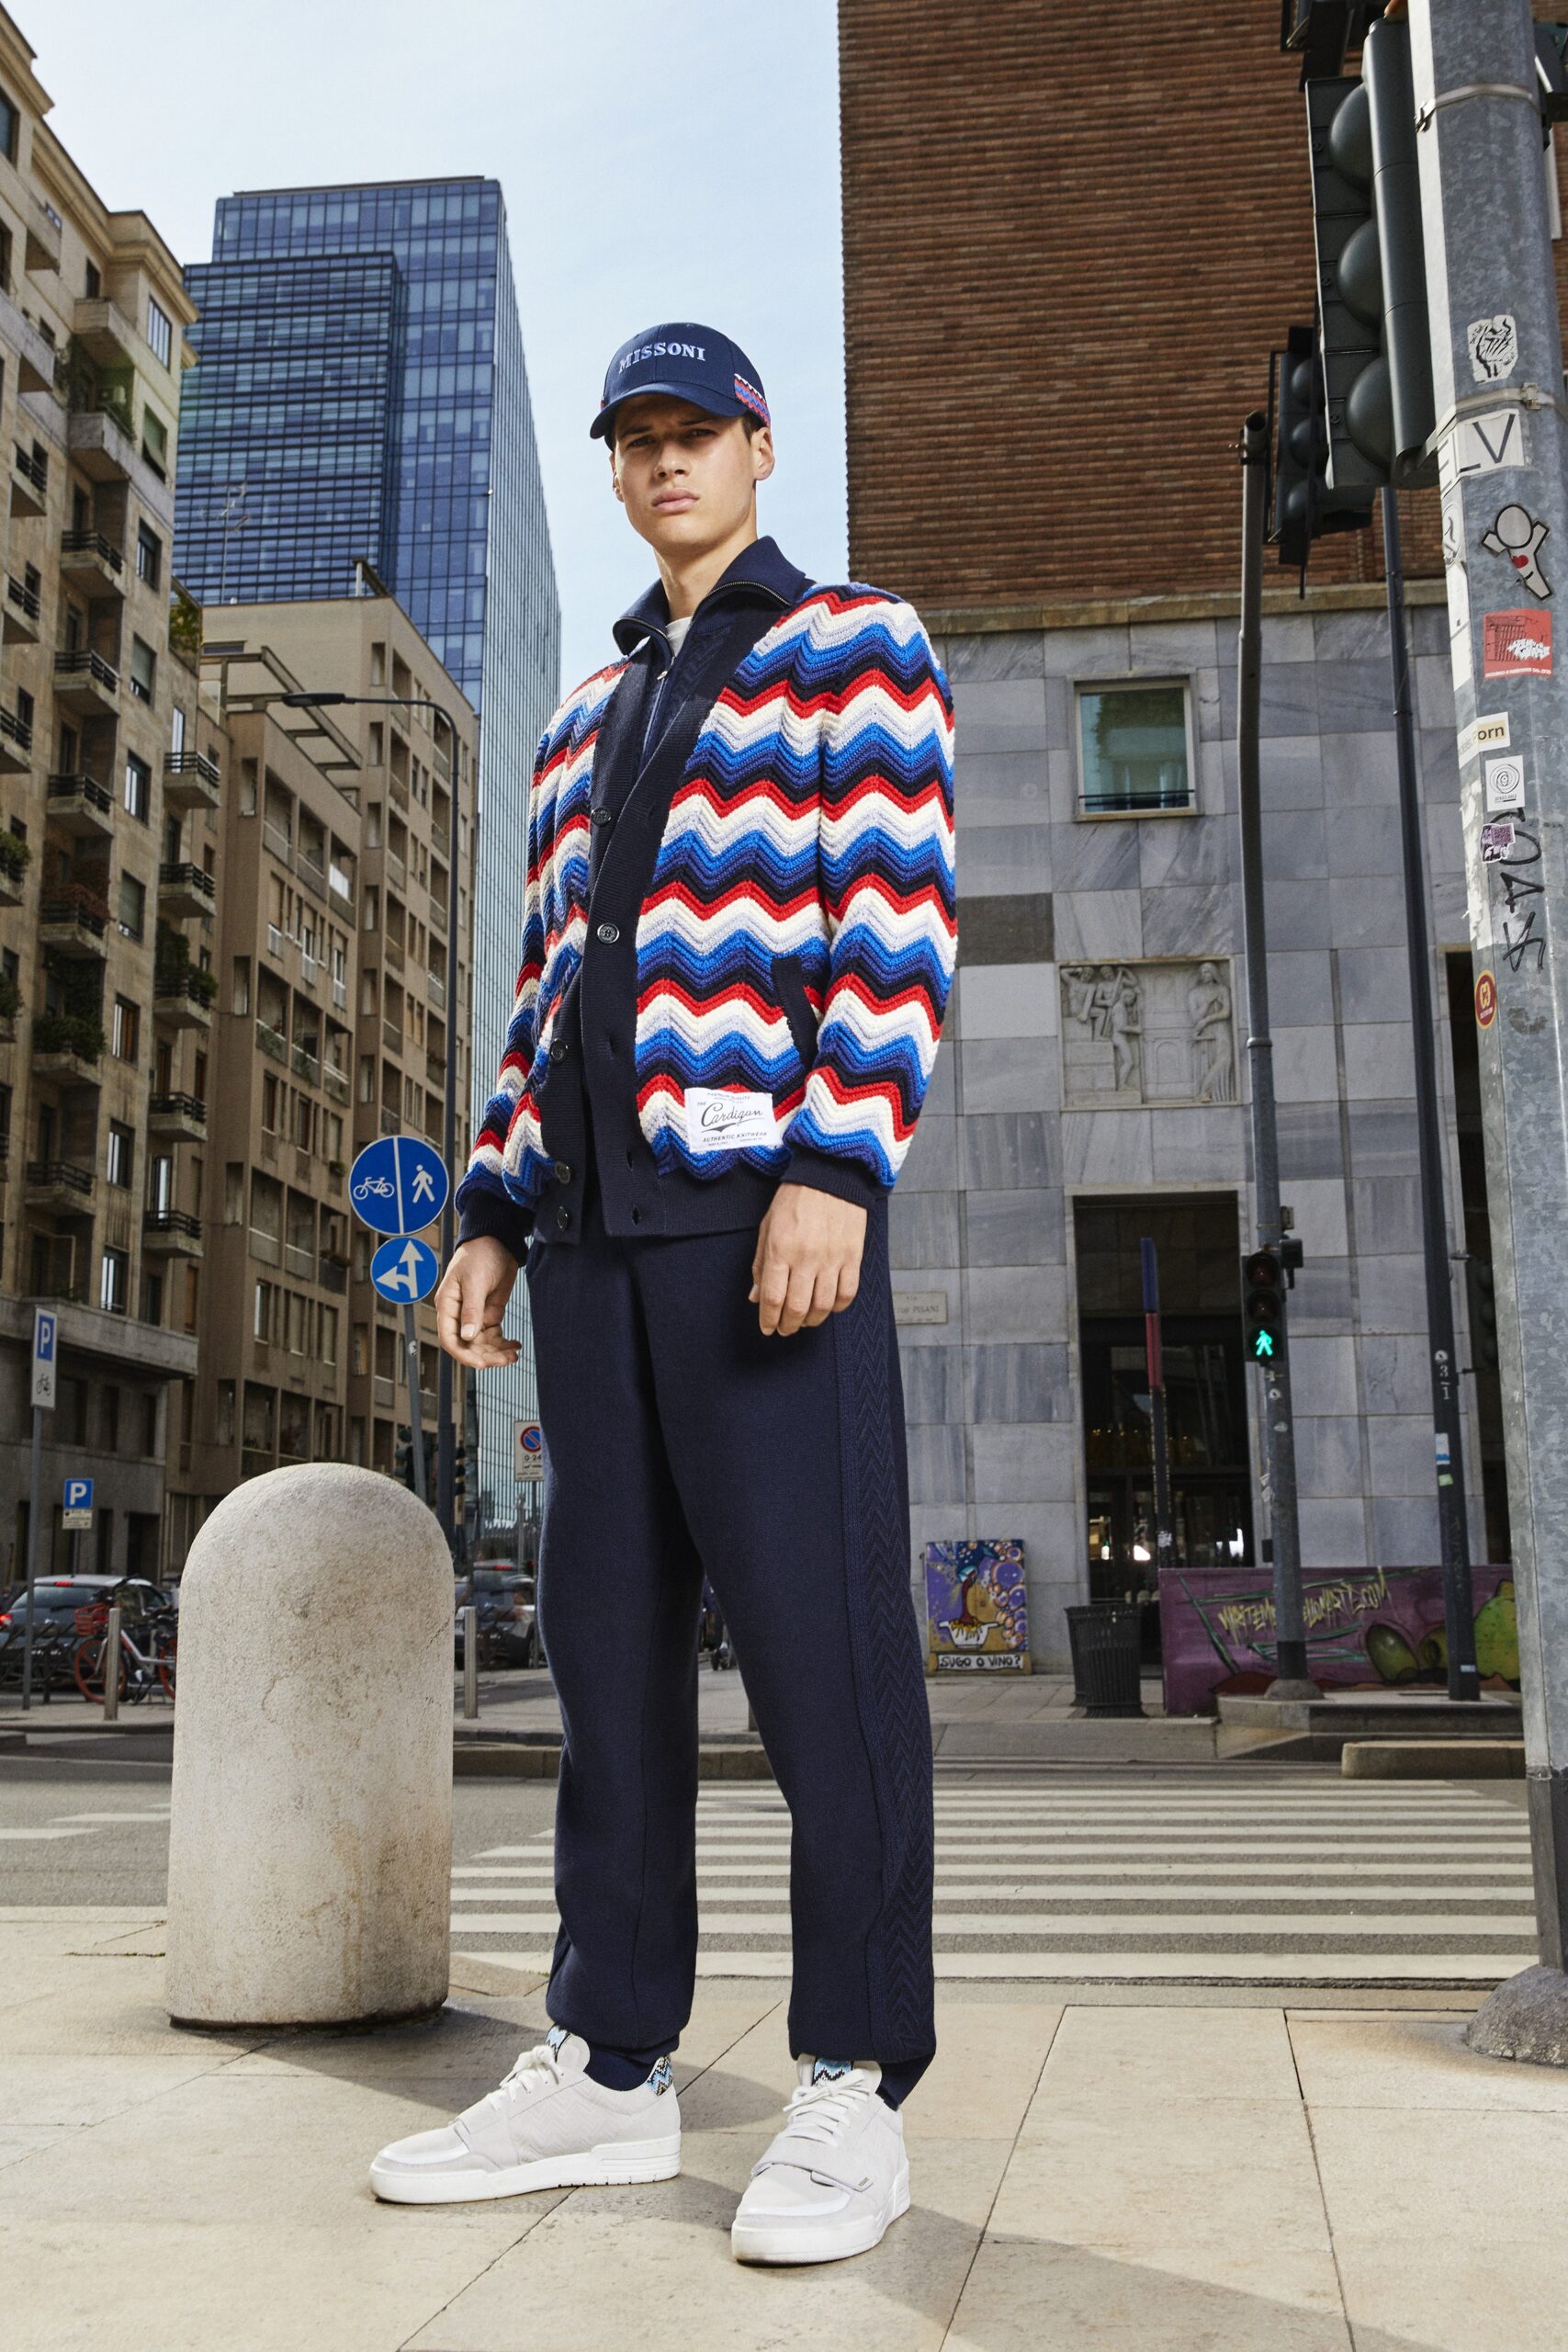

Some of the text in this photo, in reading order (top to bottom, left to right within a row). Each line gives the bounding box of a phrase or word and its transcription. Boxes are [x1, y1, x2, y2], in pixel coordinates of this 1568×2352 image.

[618, 342, 706, 374] MISSONI
[701, 1102, 763, 1127] Cardigan
[703, 1134, 736, 1143] AUTHENTIC
[40, 1321, 51, 1354] P
[70, 1483, 87, 1506] P
[940, 1655, 1021, 1668] SUGO O VINO?
